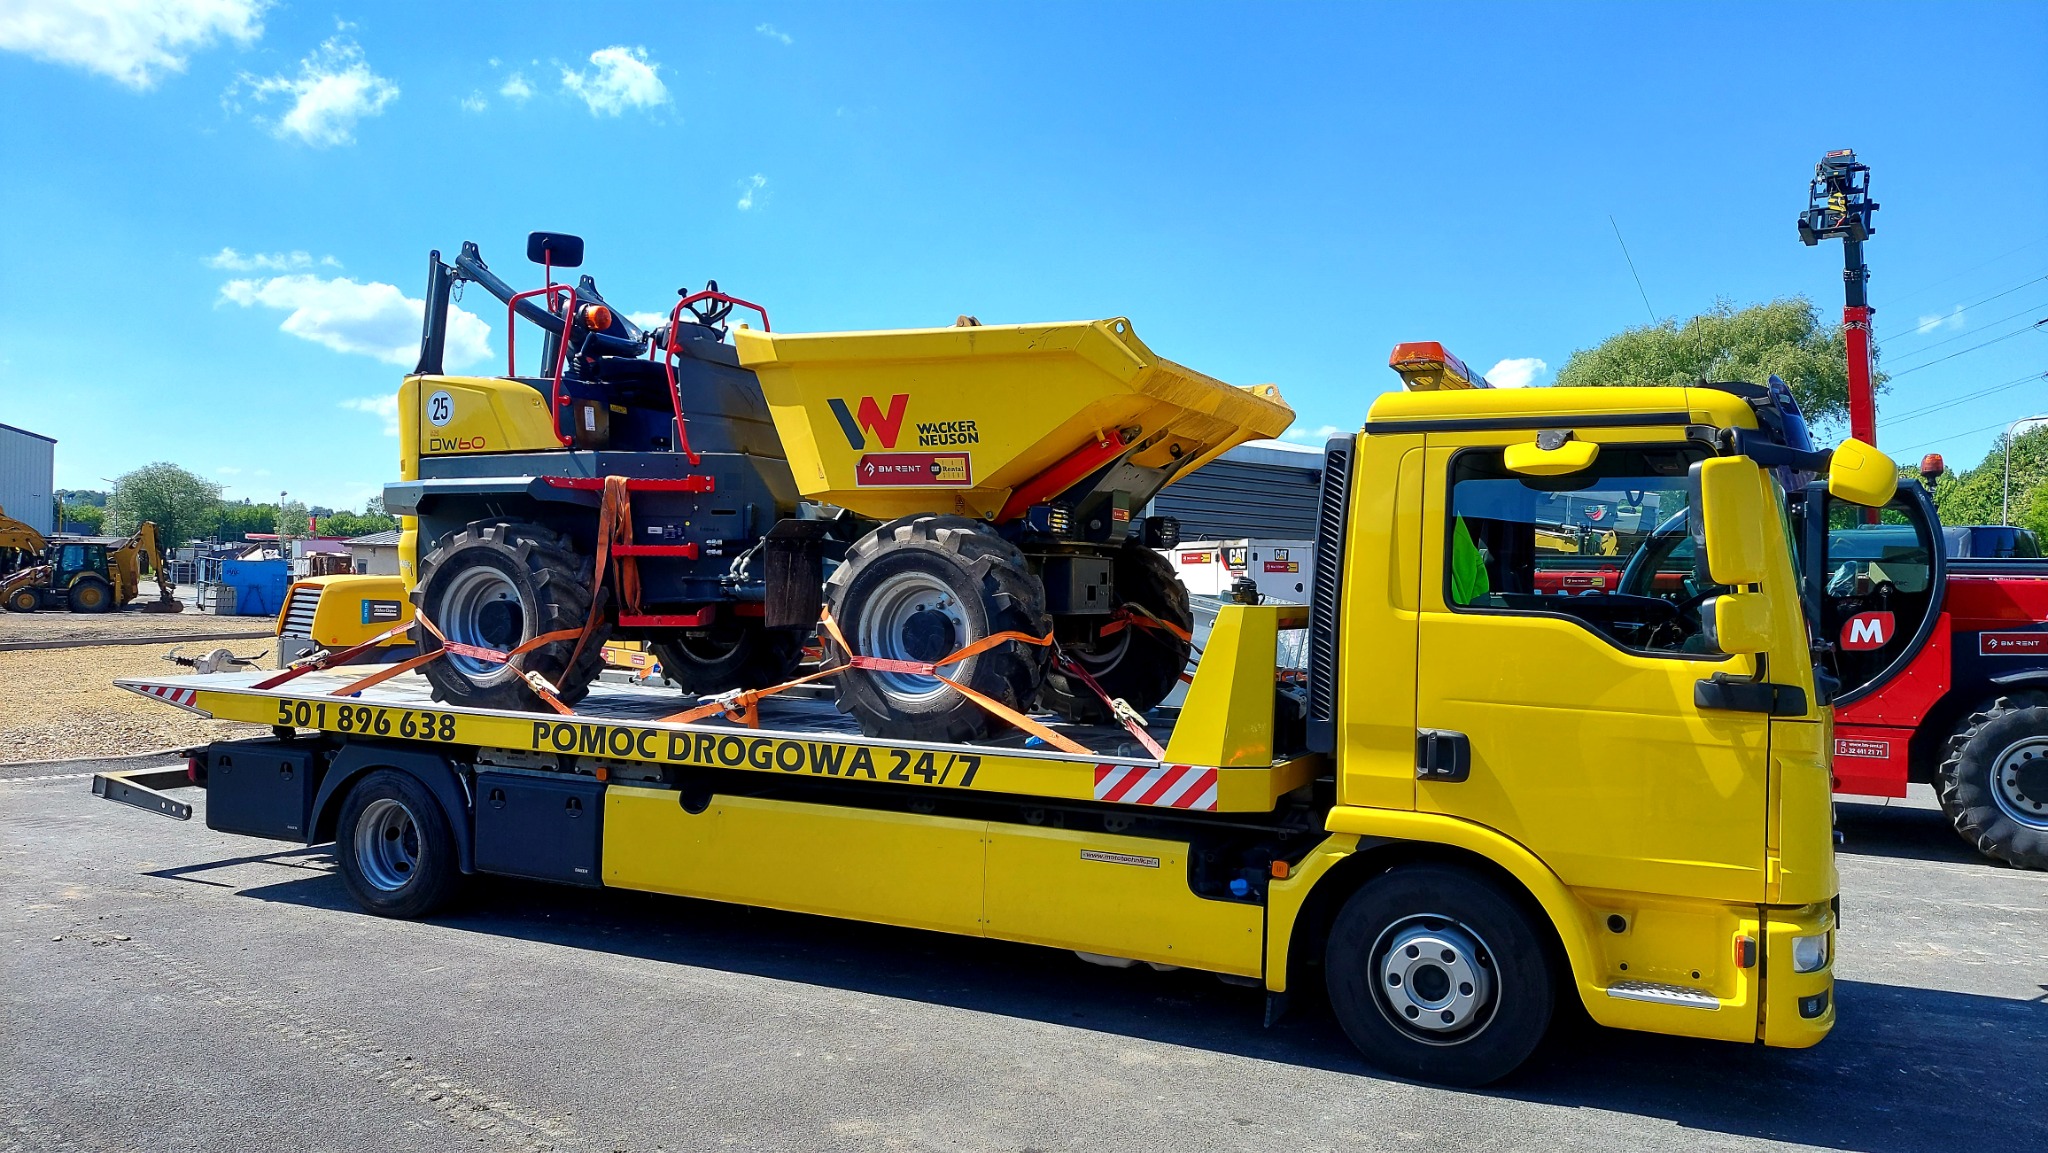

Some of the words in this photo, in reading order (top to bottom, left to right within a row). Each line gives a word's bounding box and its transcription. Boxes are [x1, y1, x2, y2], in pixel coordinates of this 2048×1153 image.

[433, 397, 449, 420] 25
[916, 421, 977, 434] WACKER
[430, 436, 486, 451] DW60
[919, 432, 979, 446] NEUSON
[1229, 548, 1247, 563] CAT
[1275, 549, 1288, 560] CAT
[1850, 619, 1883, 643] M
[278, 700, 326, 728] 501
[337, 705, 391, 735] 896
[399, 711, 456, 741] 638
[532, 722, 658, 758] POMOC
[667, 732, 877, 779] DROGOWA
[888, 750, 982, 787] 24/7
